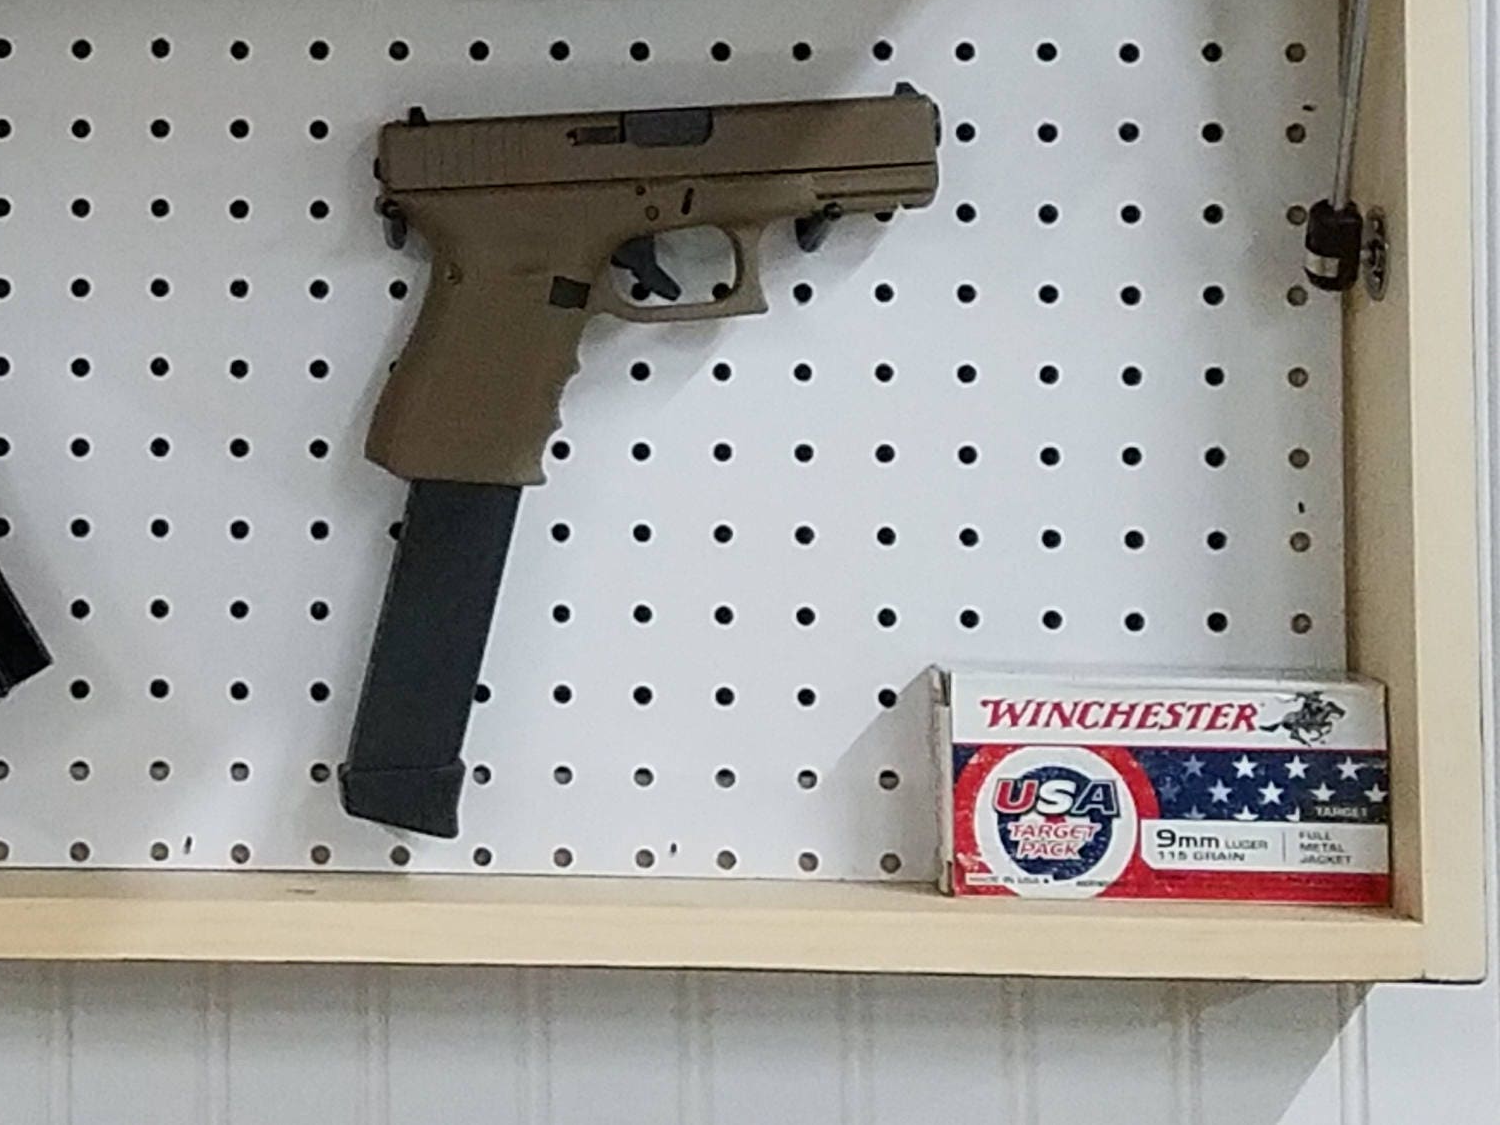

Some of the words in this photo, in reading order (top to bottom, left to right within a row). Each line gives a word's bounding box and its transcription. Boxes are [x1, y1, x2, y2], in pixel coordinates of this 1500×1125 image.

[979, 697, 1258, 732] WINCHESTER
[993, 778, 1121, 817] USA
[1314, 805, 1368, 818] TARGET
[1008, 821, 1102, 841] TARGET
[1299, 830, 1332, 841] FULL
[1156, 828, 1220, 850] 9mm
[1224, 839, 1268, 850] LUGER
[1018, 840, 1082, 858] PACK
[1299, 842, 1345, 853] METAL
[1157, 850, 1188, 862] 115
[1192, 851, 1246, 863] GRAIN
[1299, 853, 1353, 865] JACKET
